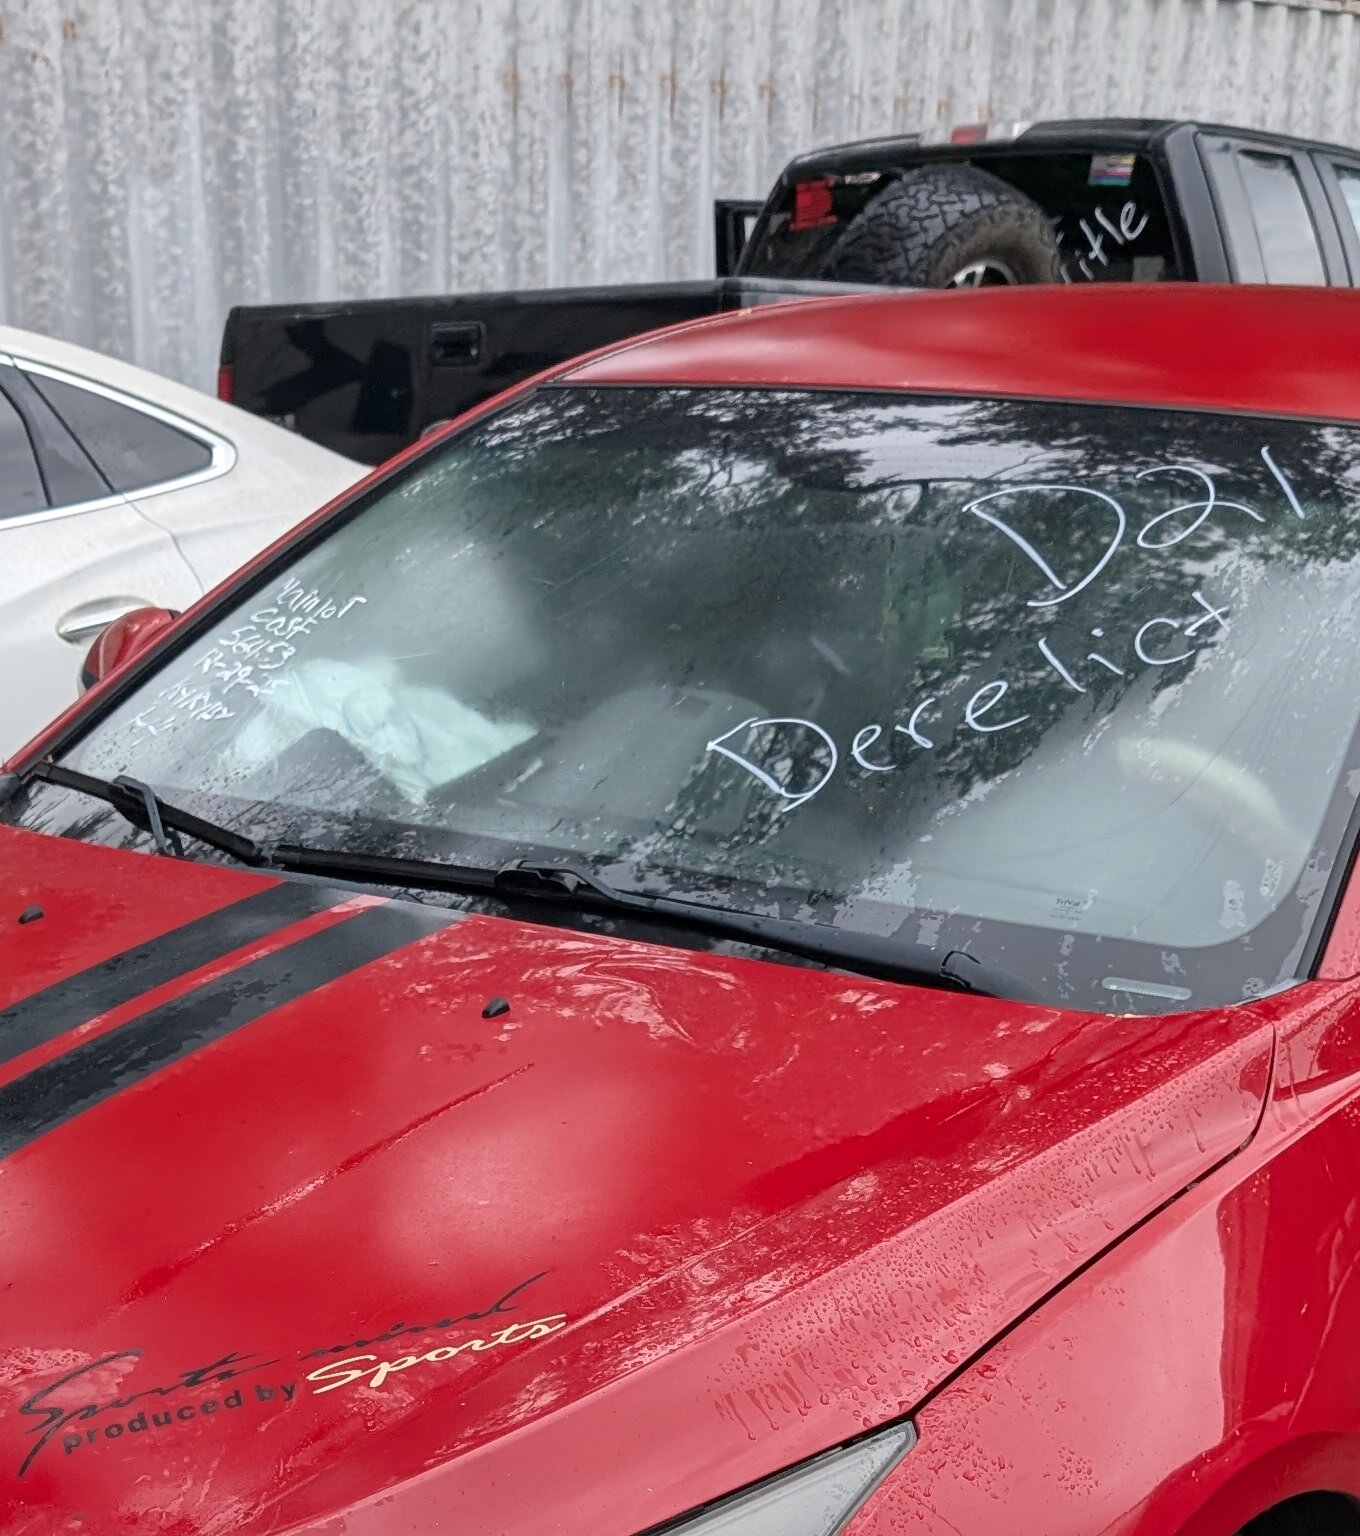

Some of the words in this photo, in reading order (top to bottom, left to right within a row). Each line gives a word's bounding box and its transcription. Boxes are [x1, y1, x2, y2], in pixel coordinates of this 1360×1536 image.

[706, 592, 1231, 813] Derelict
[62, 1389, 244, 1455] produced
[254, 1381, 297, 1403] by
[306, 1314, 566, 1394] Sports
